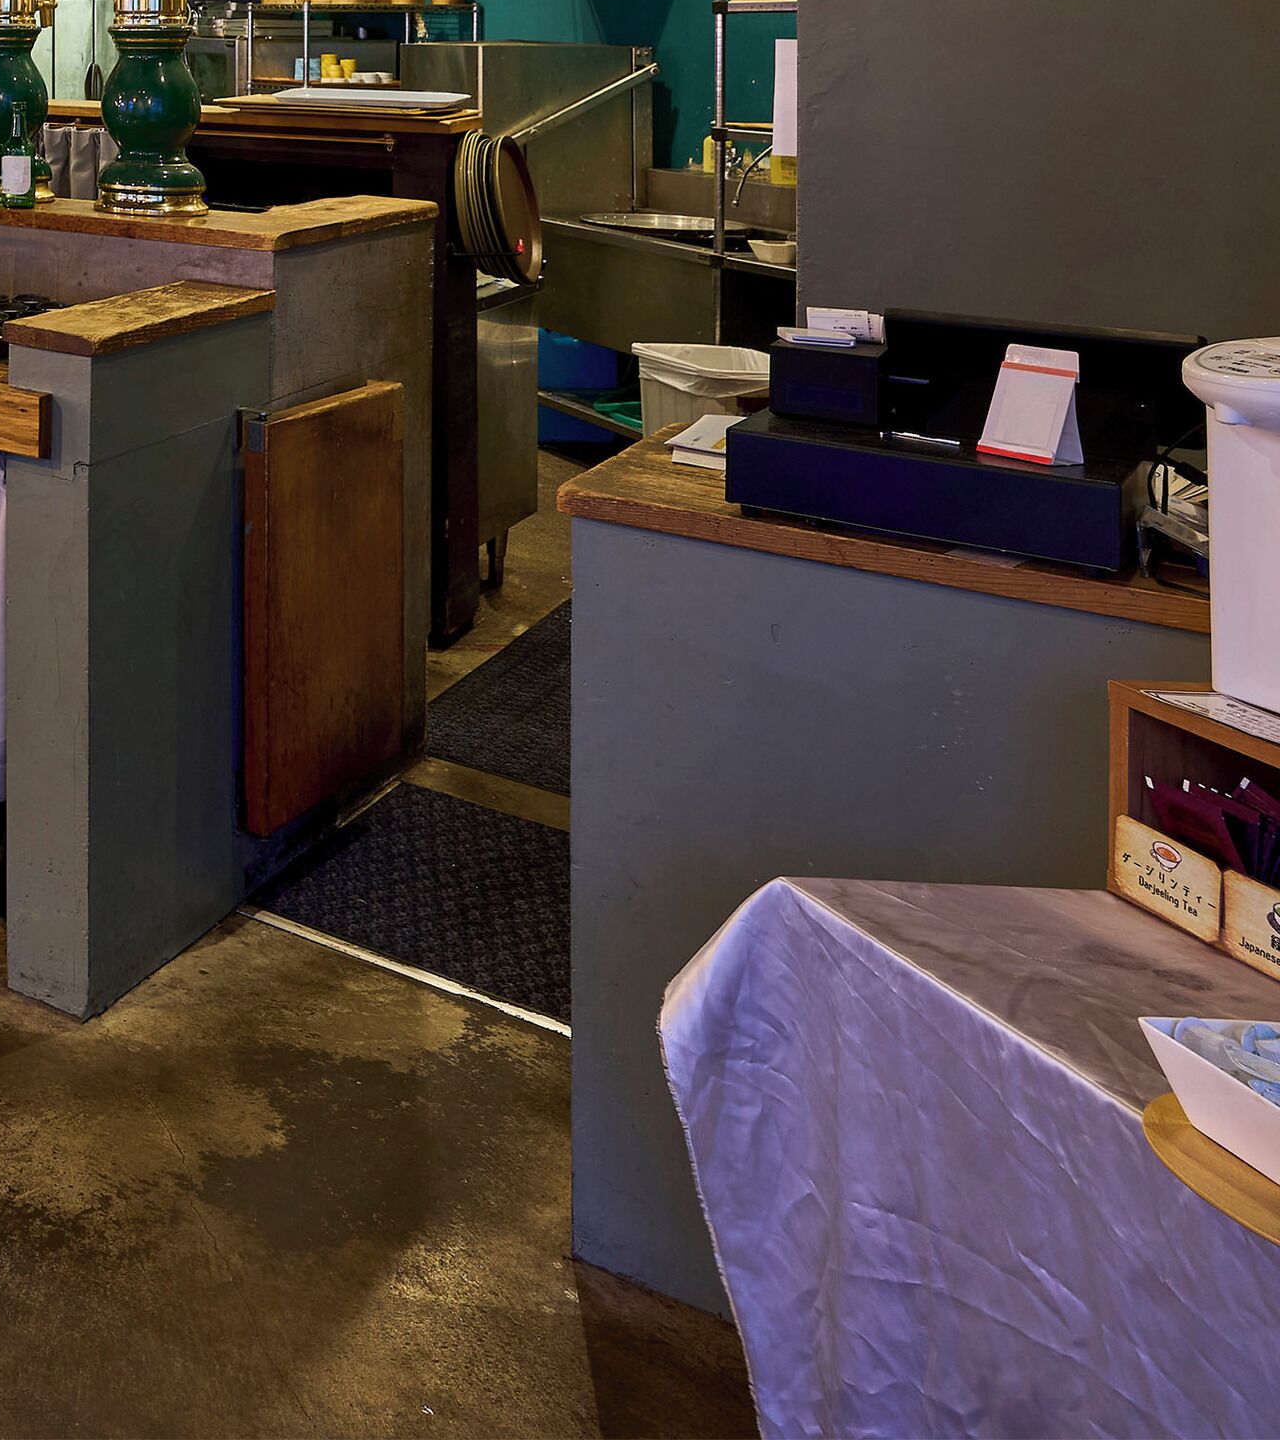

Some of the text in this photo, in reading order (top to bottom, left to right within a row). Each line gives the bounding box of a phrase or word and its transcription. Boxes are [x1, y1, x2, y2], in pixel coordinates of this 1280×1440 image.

[1122, 852, 1217, 909] ダージリンティー
[1138, 875, 1198, 917] Darjeeling Tea
